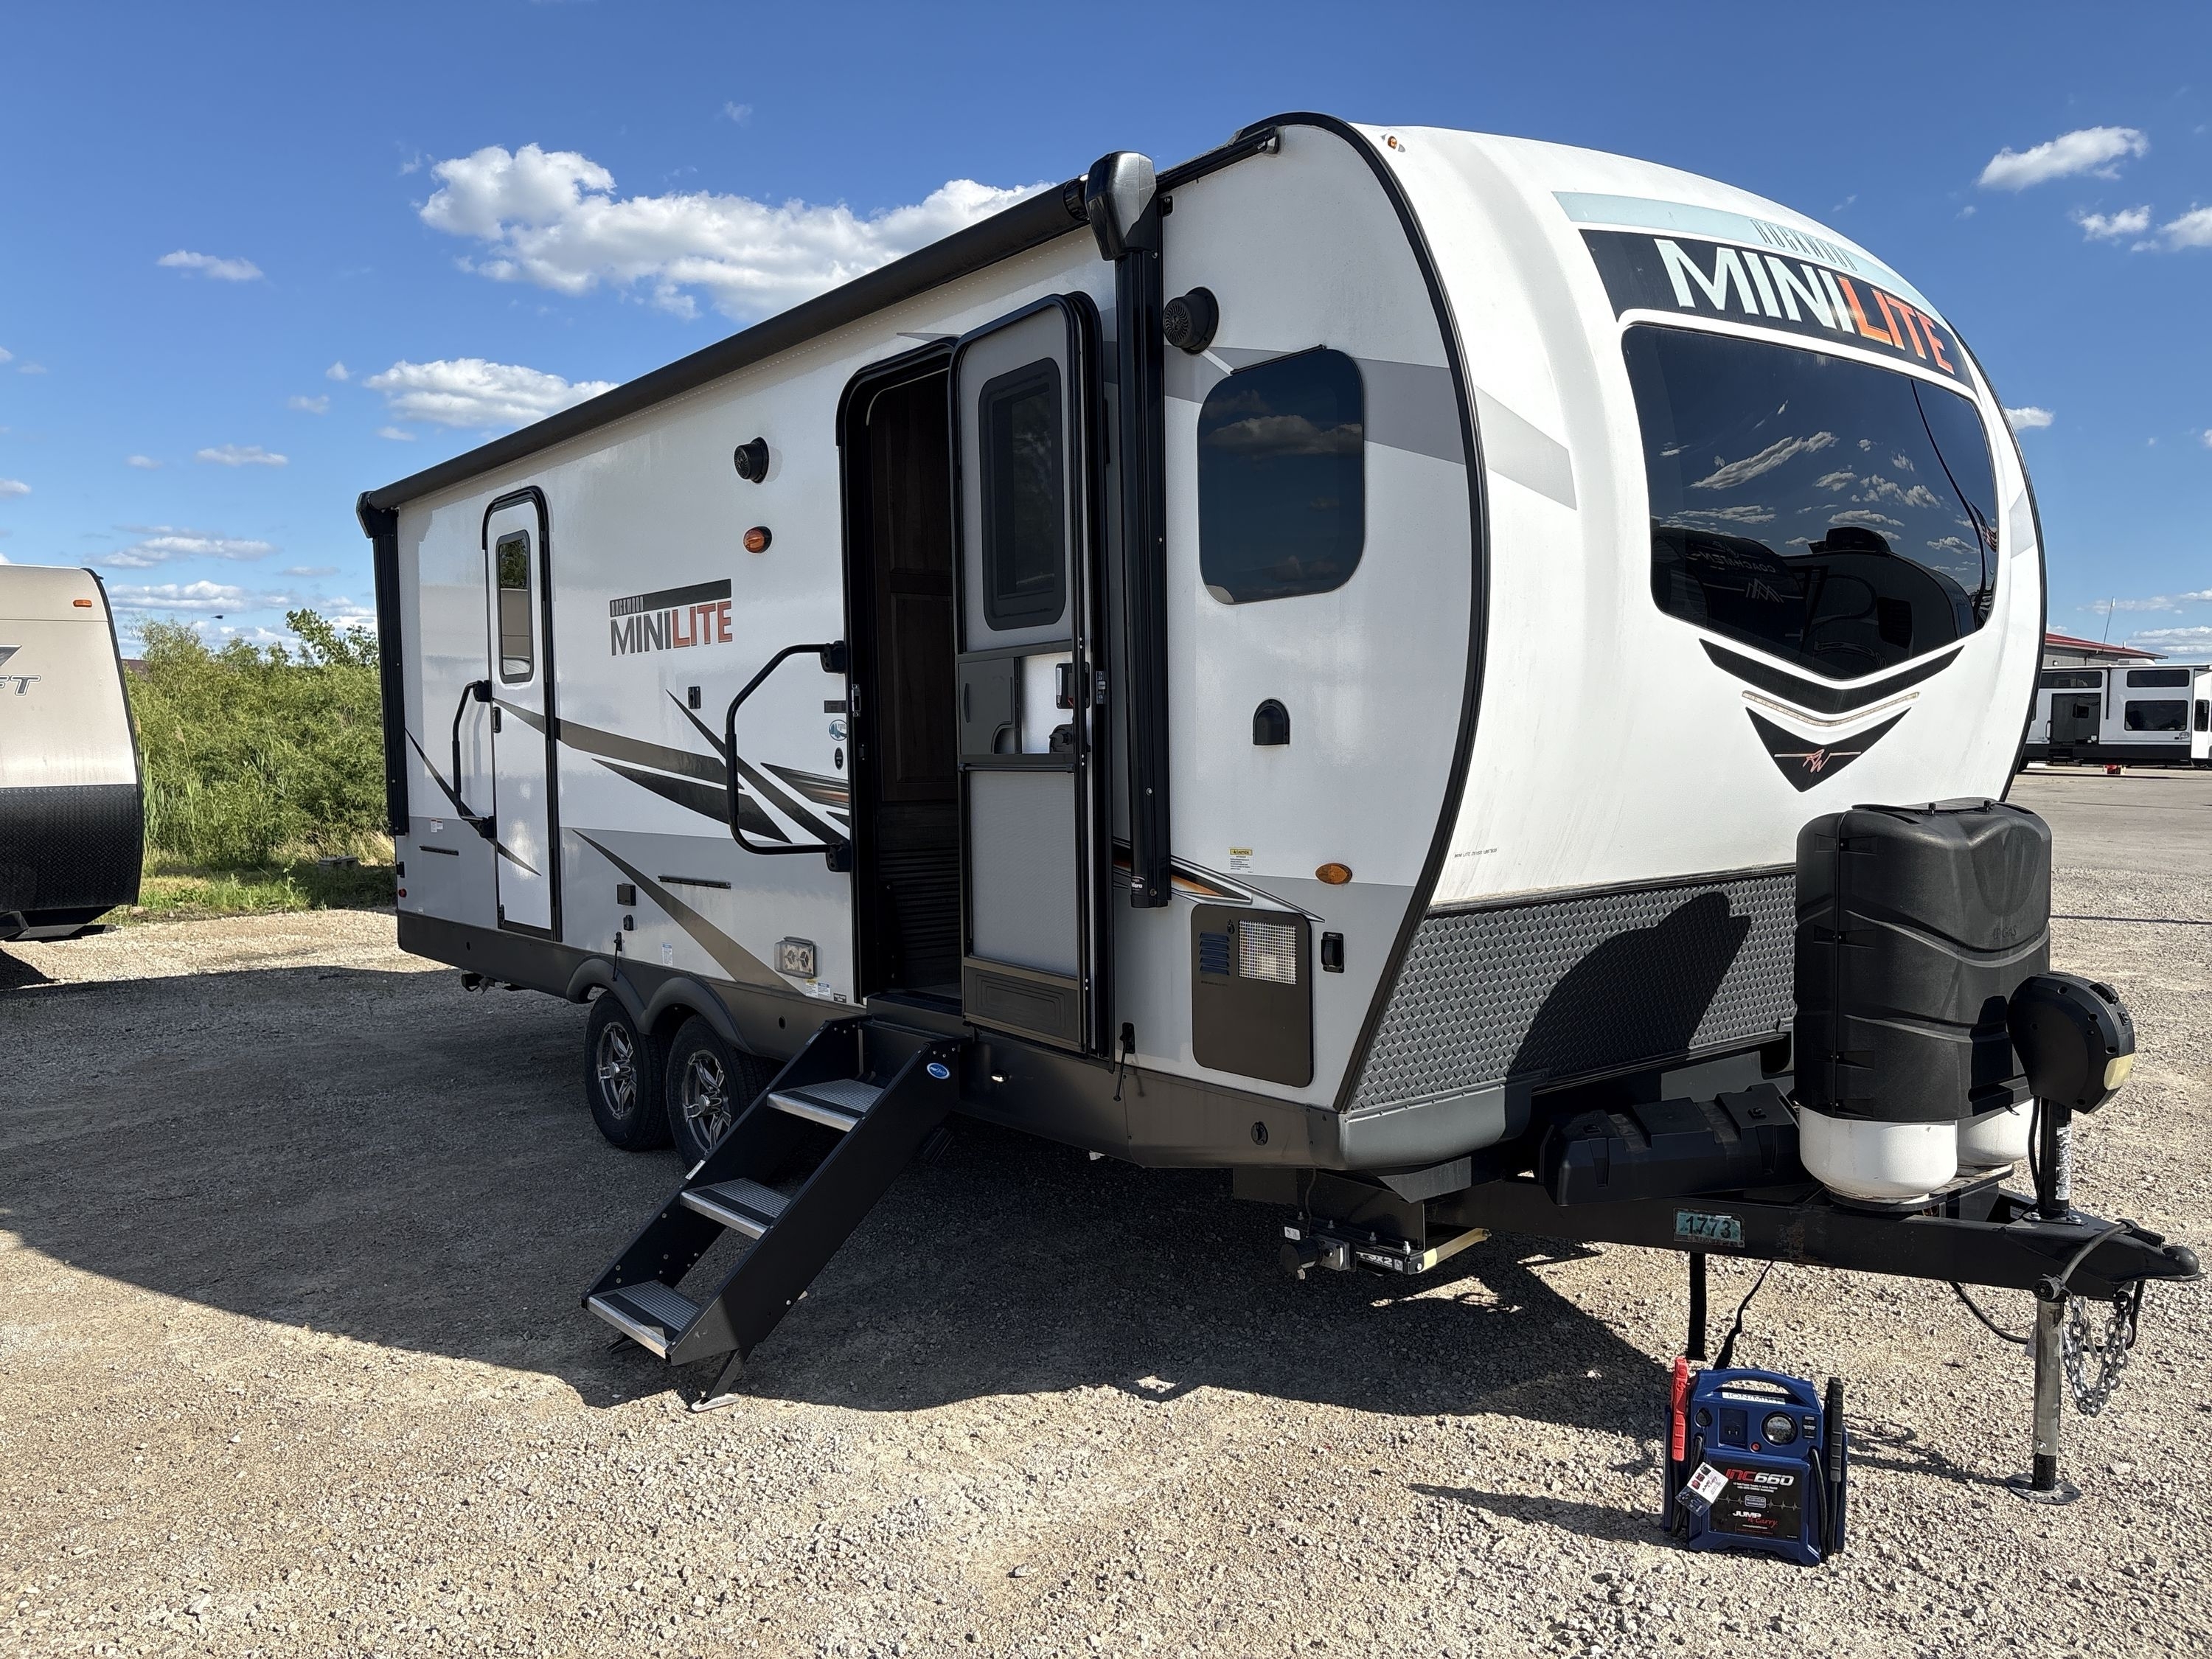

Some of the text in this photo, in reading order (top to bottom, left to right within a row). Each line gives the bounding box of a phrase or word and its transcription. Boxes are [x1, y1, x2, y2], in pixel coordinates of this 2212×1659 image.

[1750, 219, 1859, 272] ROCKWOOD
[611, 595, 644, 616] ROCKWOOD
[1686, 1215, 1731, 1239] 1773
[1732, 1510, 1762, 1519] JUMP
